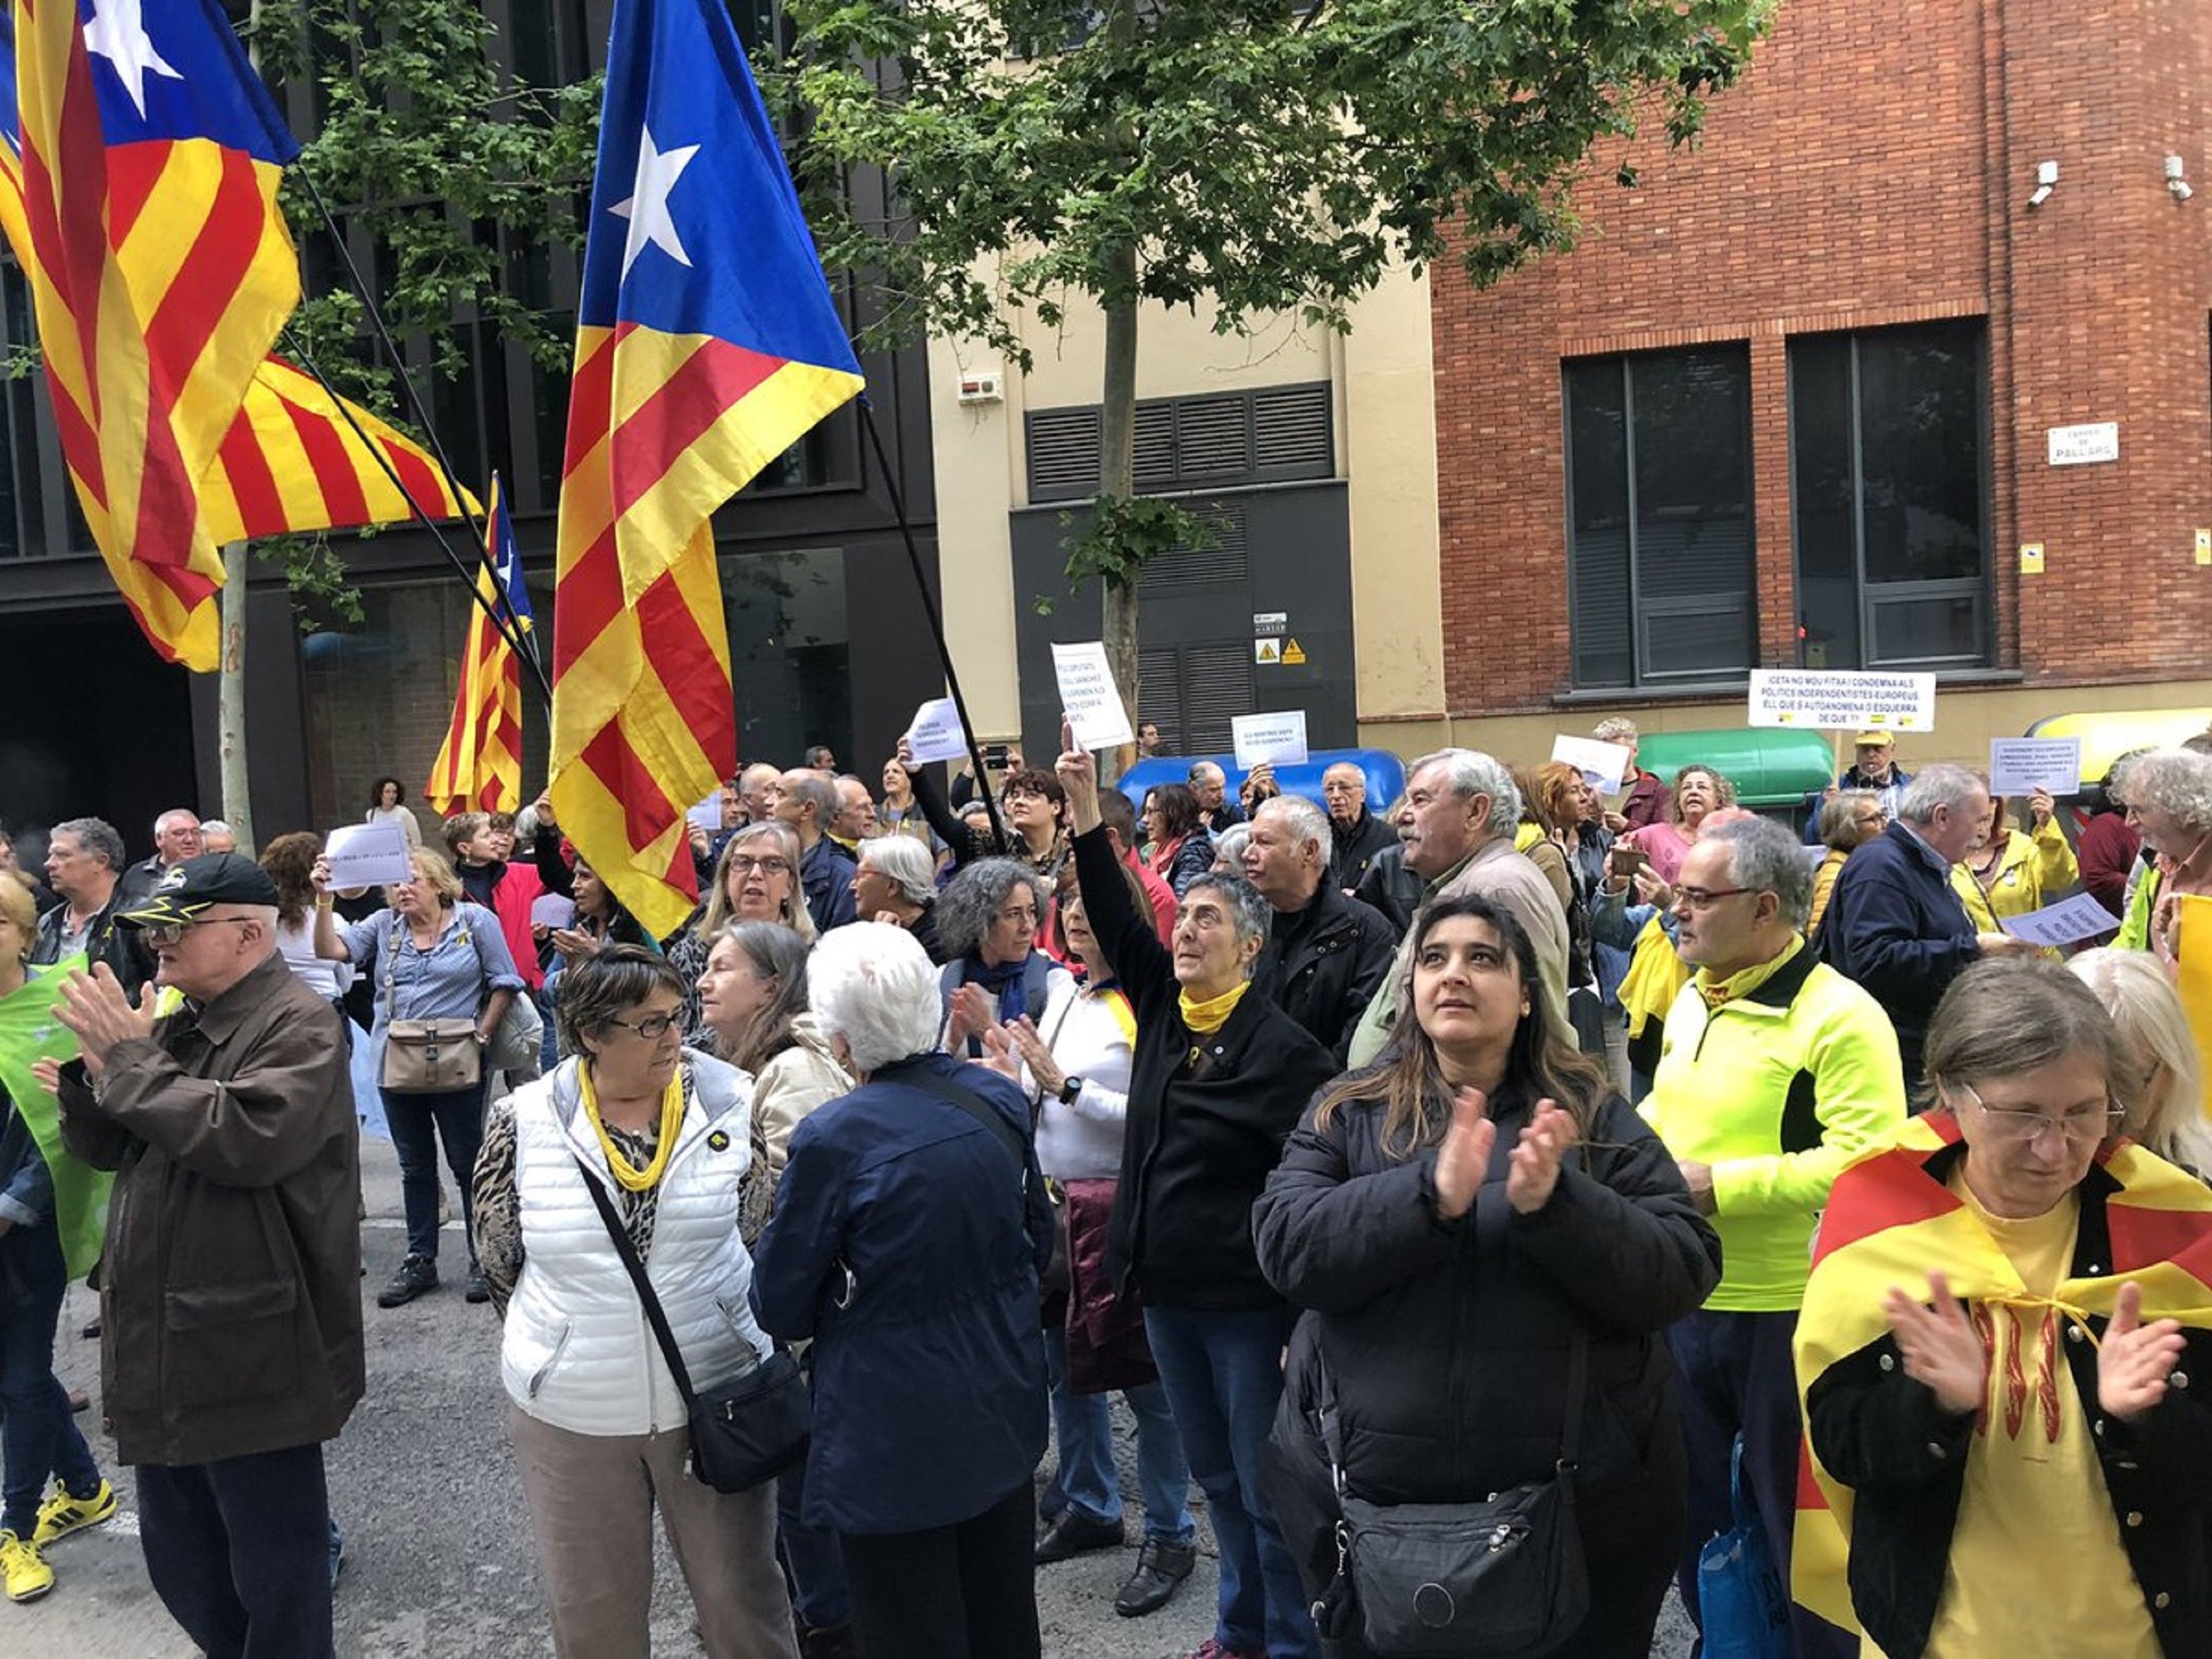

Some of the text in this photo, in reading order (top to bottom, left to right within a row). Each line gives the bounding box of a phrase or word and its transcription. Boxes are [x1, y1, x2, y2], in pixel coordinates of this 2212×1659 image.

[2056, 445, 2112, 458] PALLARS
[1791, 676, 1803, 685] NO
[1805, 677, 1823, 686] MOU
[1825, 677, 1846, 686] FITXA
[1853, 678, 1897, 688] CONDEMNA
[1898, 679, 1913, 688] ALS
[1797, 688, 1873, 699] INDEPENDENTISTES
[1779, 700, 1795, 710] QUE
[1819, 713, 1829, 723] DE
